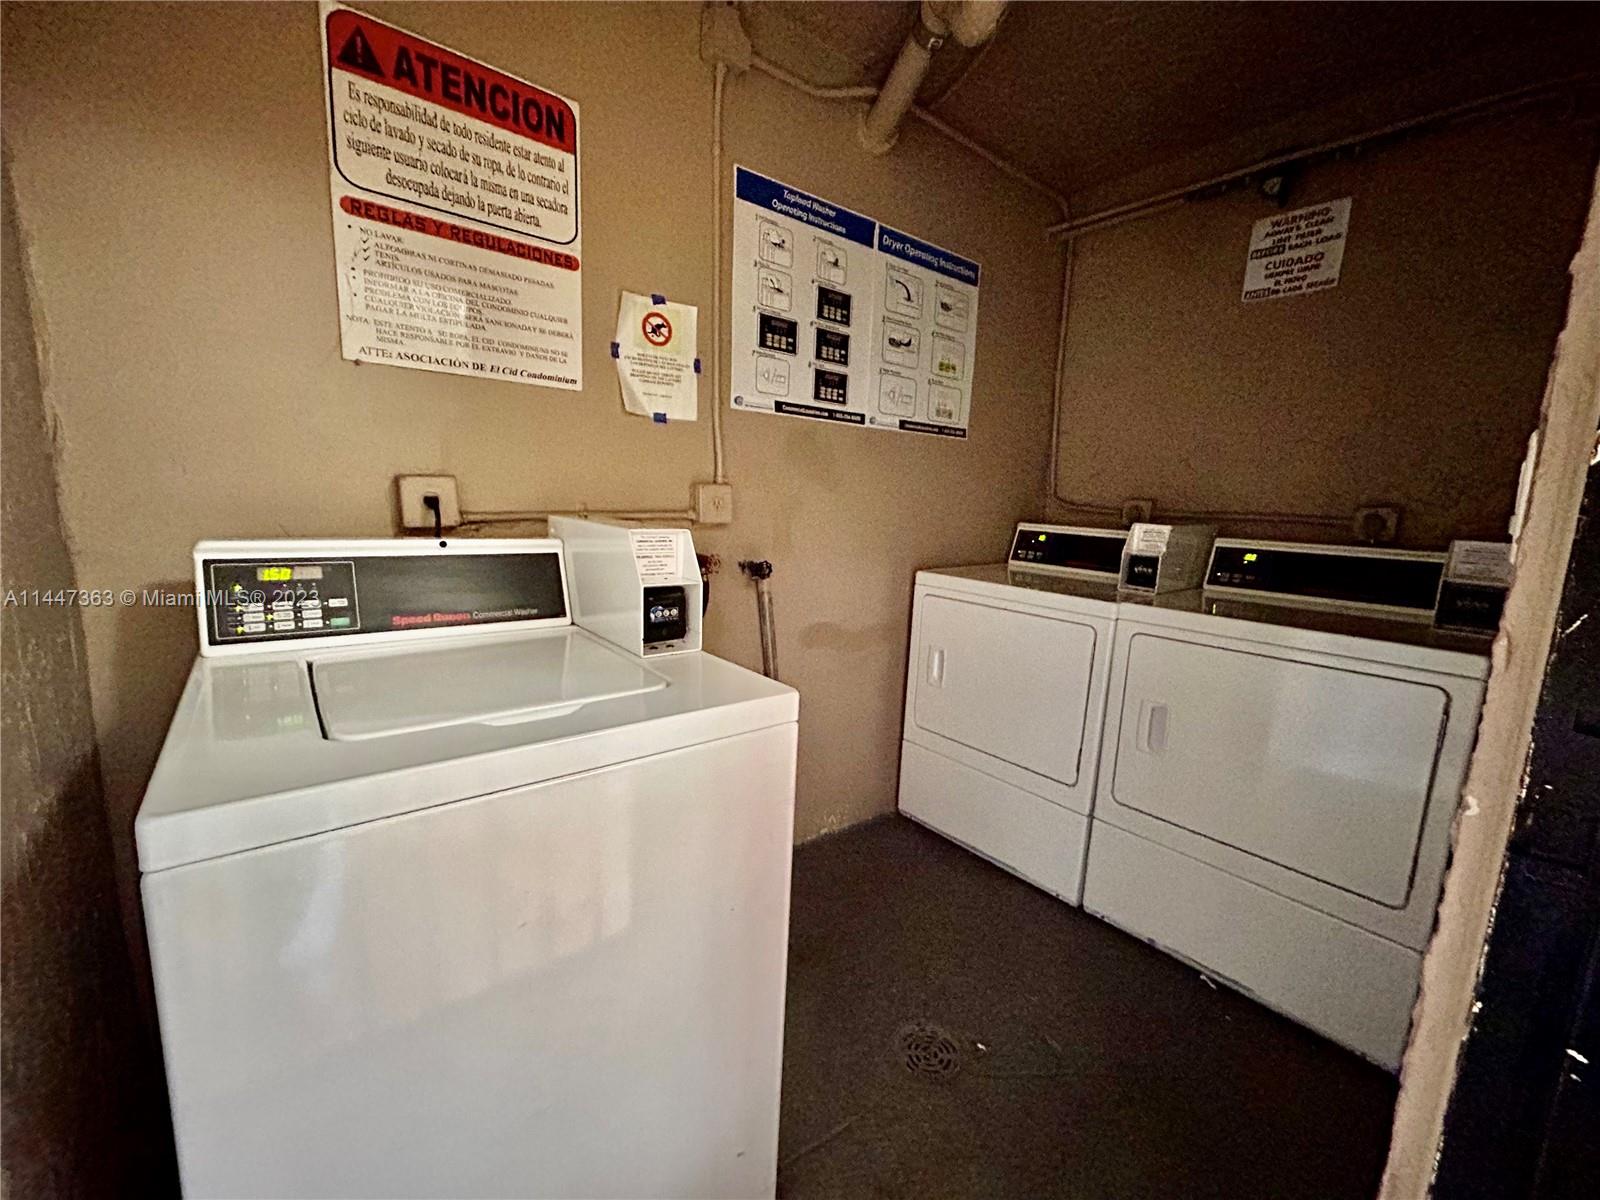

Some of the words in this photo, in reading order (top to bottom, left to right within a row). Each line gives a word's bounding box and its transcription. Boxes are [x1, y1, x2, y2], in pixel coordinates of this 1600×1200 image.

[392, 45, 567, 144] ATENCION
[348, 80, 361, 102] Es
[364, 92, 438, 129] responsabilidad
[440, 115, 451, 133] de
[453, 122, 472, 141] todo
[475, 131, 511, 154] residente
[513, 145, 532, 161] estar
[534, 152, 556, 169] atento
[558, 158, 564, 172] al
[343, 108, 368, 129] ciclo
[370, 114, 382, 133] de
[384, 118, 416, 144] lavado
[419, 135, 425, 151] y
[427, 138, 457, 158] secado
[460, 145, 470, 162] de
[472, 153, 481, 167] su
[484, 158, 504, 175] ropa,
[506, 160, 515, 177] de
[518, 163, 526, 180] lo
[527, 172, 560, 192] contrario
[562, 180, 569, 195] el
[346, 132, 391, 160] siguiente
[394, 151, 428, 172] usuario
[430, 161, 468, 185] colocará
[471, 170, 478, 187] la
[481, 176, 507, 197] misma
[509, 188, 518, 200] en
[521, 191, 534, 205] una
[536, 196, 568, 215] secadora
[386, 168, 439, 198] desocupada
[442, 184, 475, 209] dejando
[478, 195, 485, 212] la
[487, 203, 512, 219] puerta
[514, 207, 541, 228] abierta.
[783, 189, 811, 208] Topload
[812, 202, 836, 217] Washer
[351, 198, 426, 232] REGLAS
[433, 222, 447, 237] Y
[451, 227, 573, 268] REGULACIONES
[360, 227, 373, 237] NO
[772, 199, 808, 221] Operating
[809, 213, 846, 234] Instructions
[375, 242, 426, 260] ALFOMBRAS
[428, 254, 437, 263] NI
[438, 257, 477, 272] CORTINAS
[479, 265, 522, 282] DEMASIADO
[882, 235, 904, 252] Dryer
[904, 244, 938, 267] Operating
[940, 258, 975, 279] Instructions
[1265, 252, 1324, 270] CUIDADO
[363, 269, 411, 285] PROHIBIDO
[412, 280, 423, 288] SU
[425, 281, 441, 291] USO
[424, 269, 456, 283] USADOS
[458, 276, 477, 287] PARA
[363, 277, 409, 293] INFORMAR
[419, 288, 430, 297] LA
[465, 299, 479, 307] DEL
[481, 302, 529, 316] CONDOMINIO
[529, 311, 568, 324] CUALQUIER
[364, 287, 411, 301] PROBLEMA
[413, 295, 430, 305] CON
[433, 300, 448, 309] LOS
[364, 295, 415, 310] CUALQUIER
[485, 317, 532, 332] SANCIONADA
[365, 303, 394, 315] PAGAR
[396, 308, 407, 317] LA
[410, 312, 437, 323] MULTA
[374, 320, 393, 328] ESTE
[396, 323, 426, 334] ATENTO
[550, 348, 560, 356] NO
[376, 327, 397, 337] HACE
[400, 330, 453, 346] RESPONSABLE
[456, 340, 469, 348] POR
[359, 346, 392, 358] ATTE:
[396, 351, 469, 369] ASOCIACIÓN
[472, 362, 487, 372] DE
[490, 364, 500, 373] El
[502, 366, 518, 376] Cid
[520, 369, 577, 385] Condominium
[392, 613, 432, 625] Speed
[433, 612, 471, 622] Queen
[472, 609, 512, 619] Commercial
[514, 608, 538, 616] Washer
